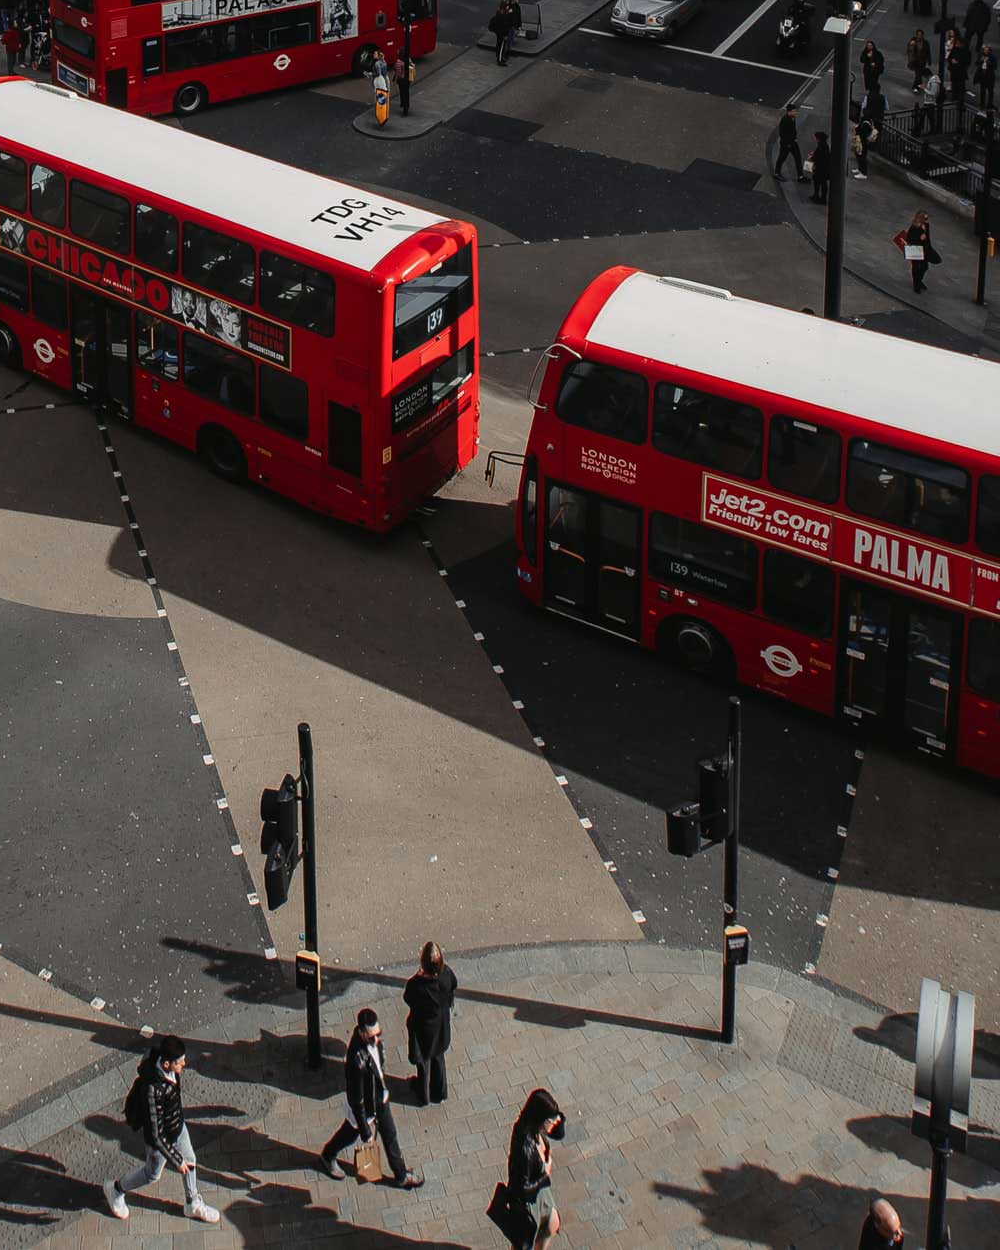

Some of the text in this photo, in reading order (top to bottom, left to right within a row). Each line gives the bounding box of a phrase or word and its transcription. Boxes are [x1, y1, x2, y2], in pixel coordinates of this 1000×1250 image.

[310, 198, 370, 225] TDG
[333, 206, 406, 241] VH14
[26, 229, 169, 311] CHICAGO
[427, 308, 443, 333] 139
[394, 384, 428, 411] LONDON
[581, 446, 637, 471] LONDON
[581, 455, 637, 479] SOVEREIGN
[708, 503, 828, 551] Friendly low fares
[710, 488, 830, 539] Jet2.com
[670, 561, 688, 576] 139
[853, 528, 950, 593] PALMA
[977, 567, 999, 582] FROM
